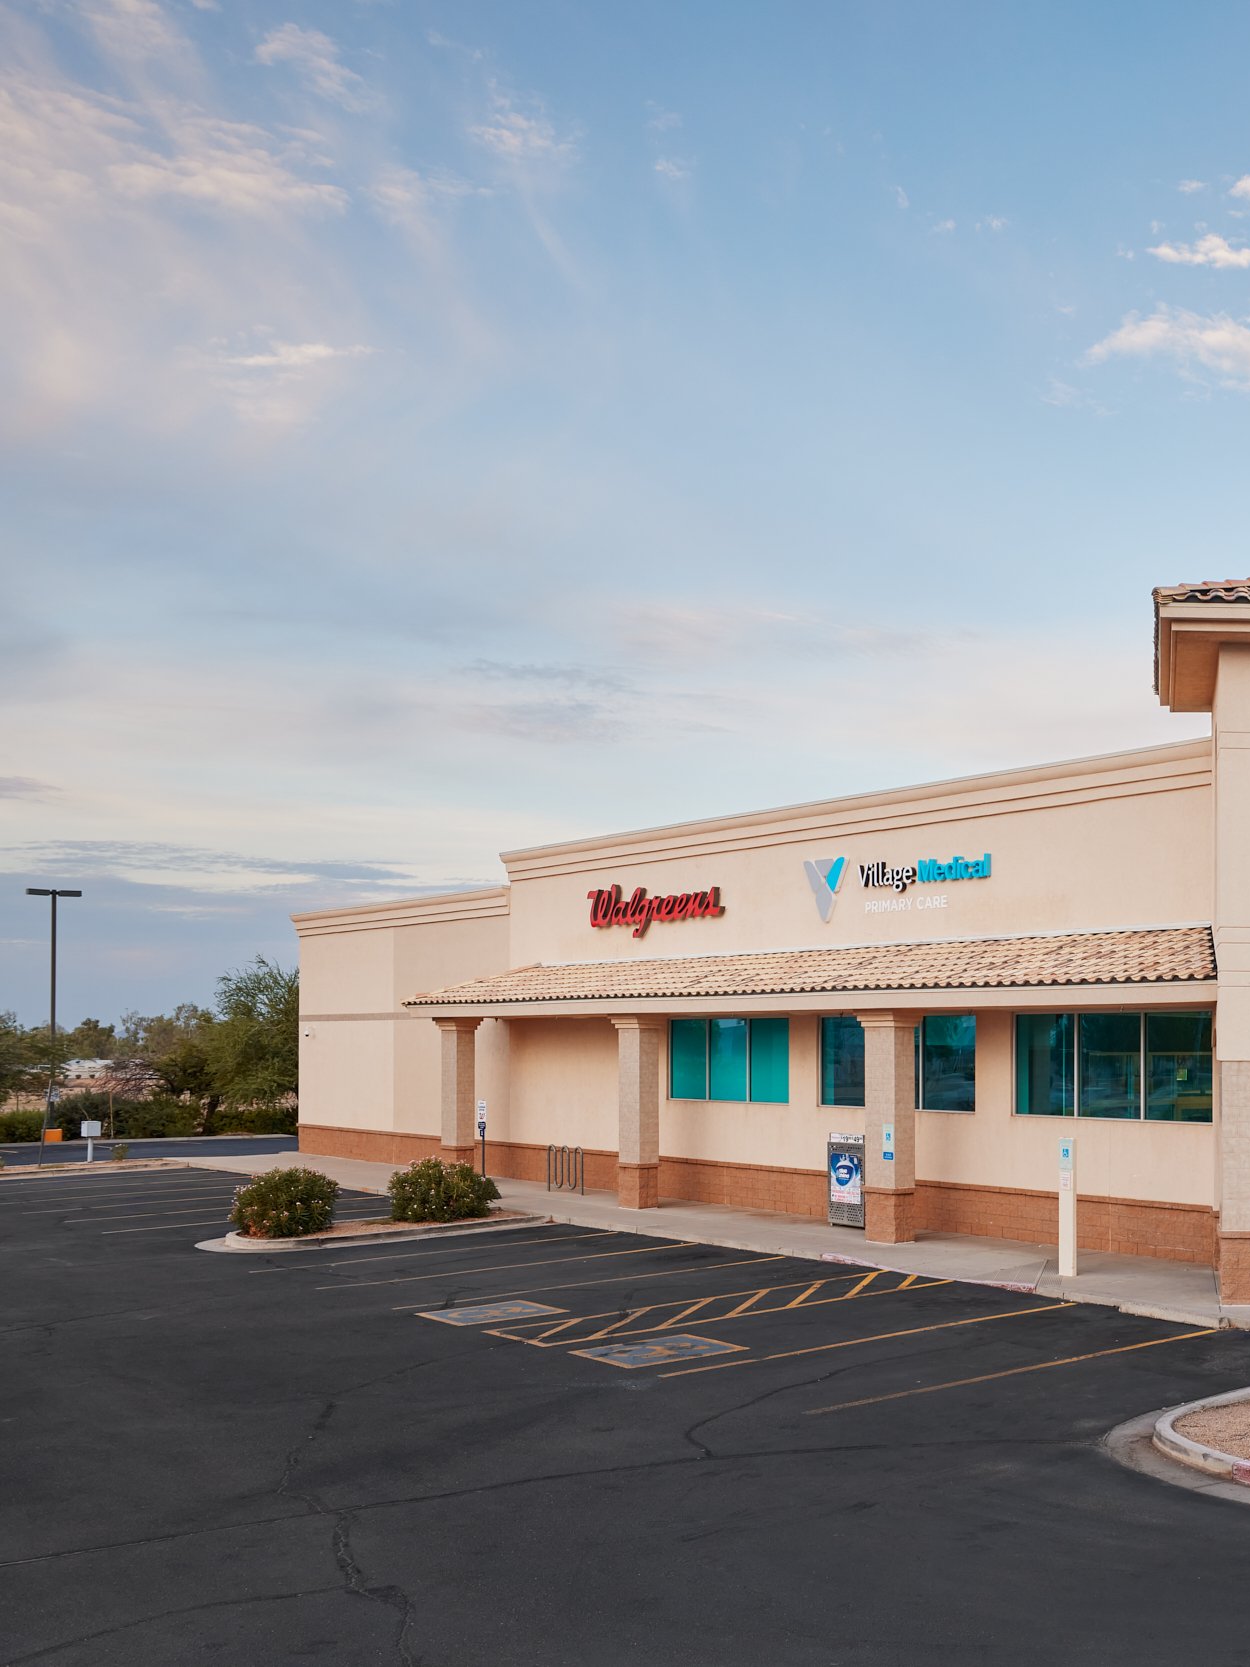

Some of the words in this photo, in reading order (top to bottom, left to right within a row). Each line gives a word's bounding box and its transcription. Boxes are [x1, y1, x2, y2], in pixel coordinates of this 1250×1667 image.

[858, 861, 917, 893] Village
[917, 853, 991, 883] Medical
[587, 884, 725, 938] Walgreens
[865, 897, 913, 914] PRIMARY
[916, 895, 949, 909] CARE
